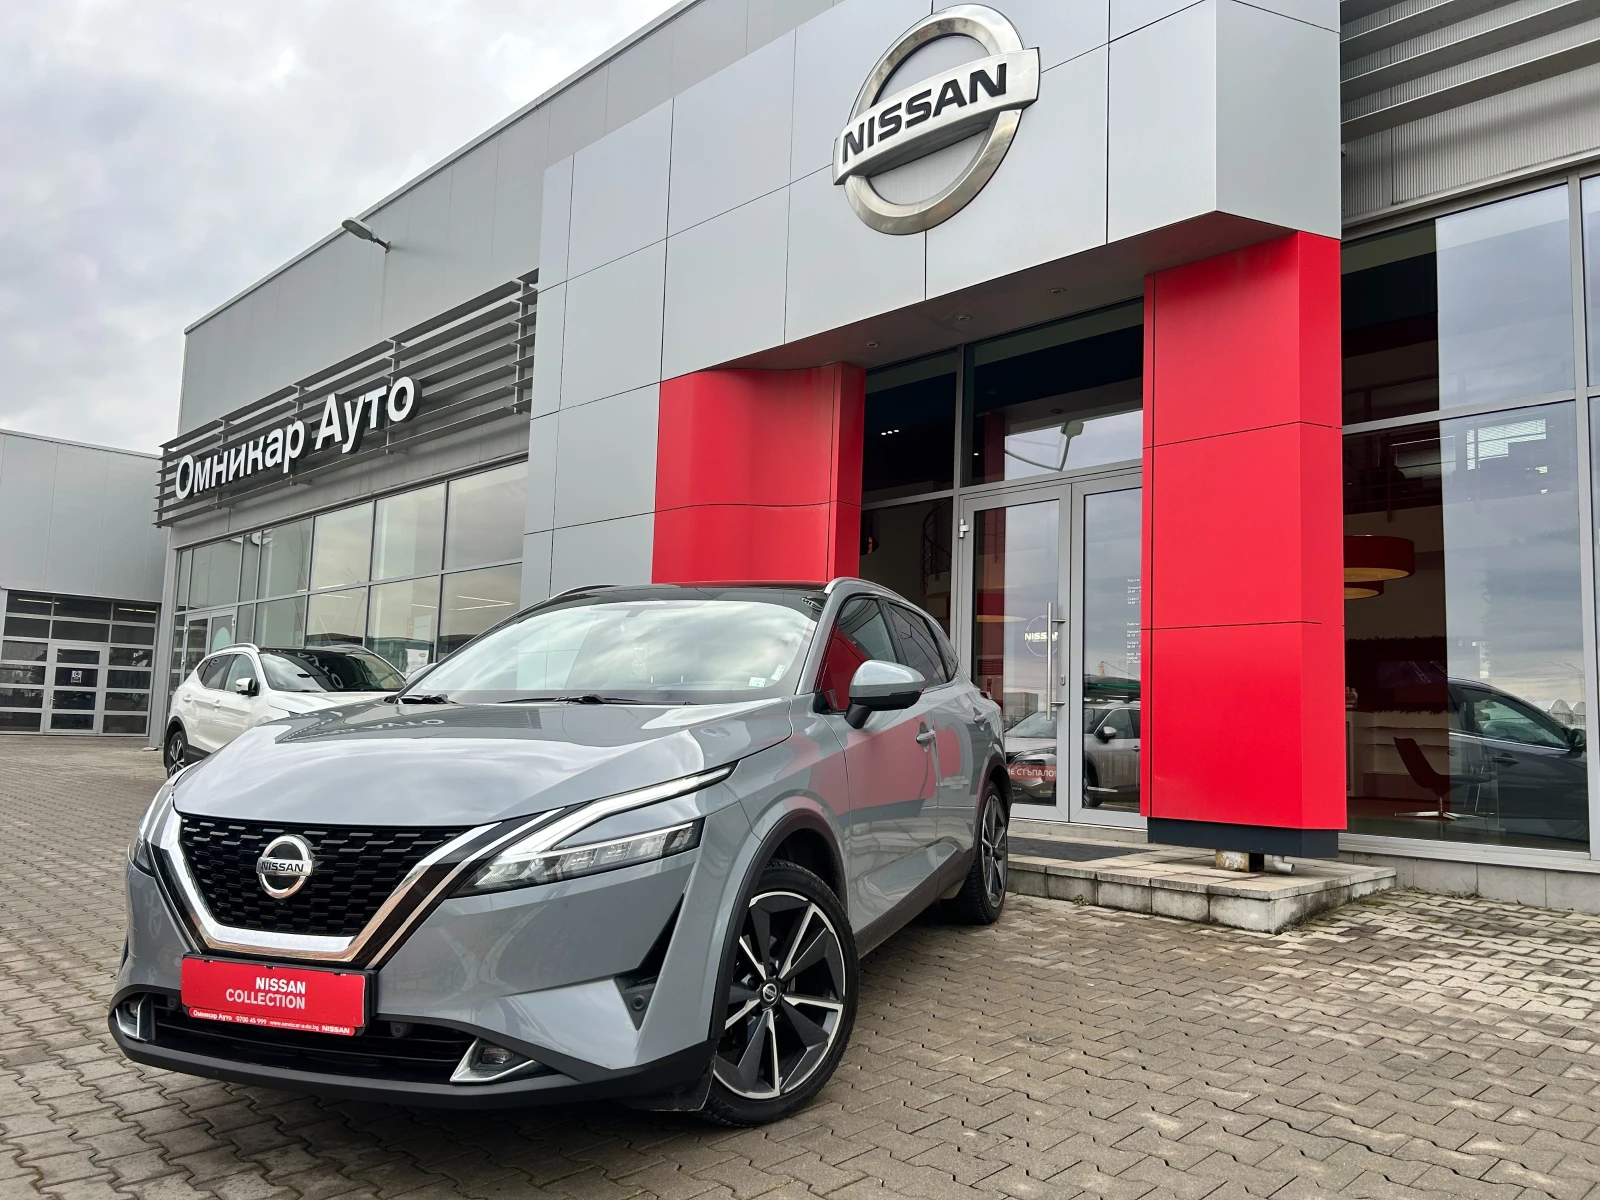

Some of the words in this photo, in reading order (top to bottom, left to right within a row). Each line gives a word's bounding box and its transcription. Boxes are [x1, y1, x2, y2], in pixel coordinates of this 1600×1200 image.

[842, 63, 1007, 164] NISSAN
[175, 420, 305, 500] Омникар
[315, 376, 415, 453] Ауто
[1024, 631, 1059, 641] NISS
[261, 861, 304, 872] NISSAN
[255, 977, 306, 994] NISSAN
[226, 988, 305, 1010] COLLECTION
[218, 1013, 232, 1021] Ауто
[321, 1025, 350, 1034] NISSAN
